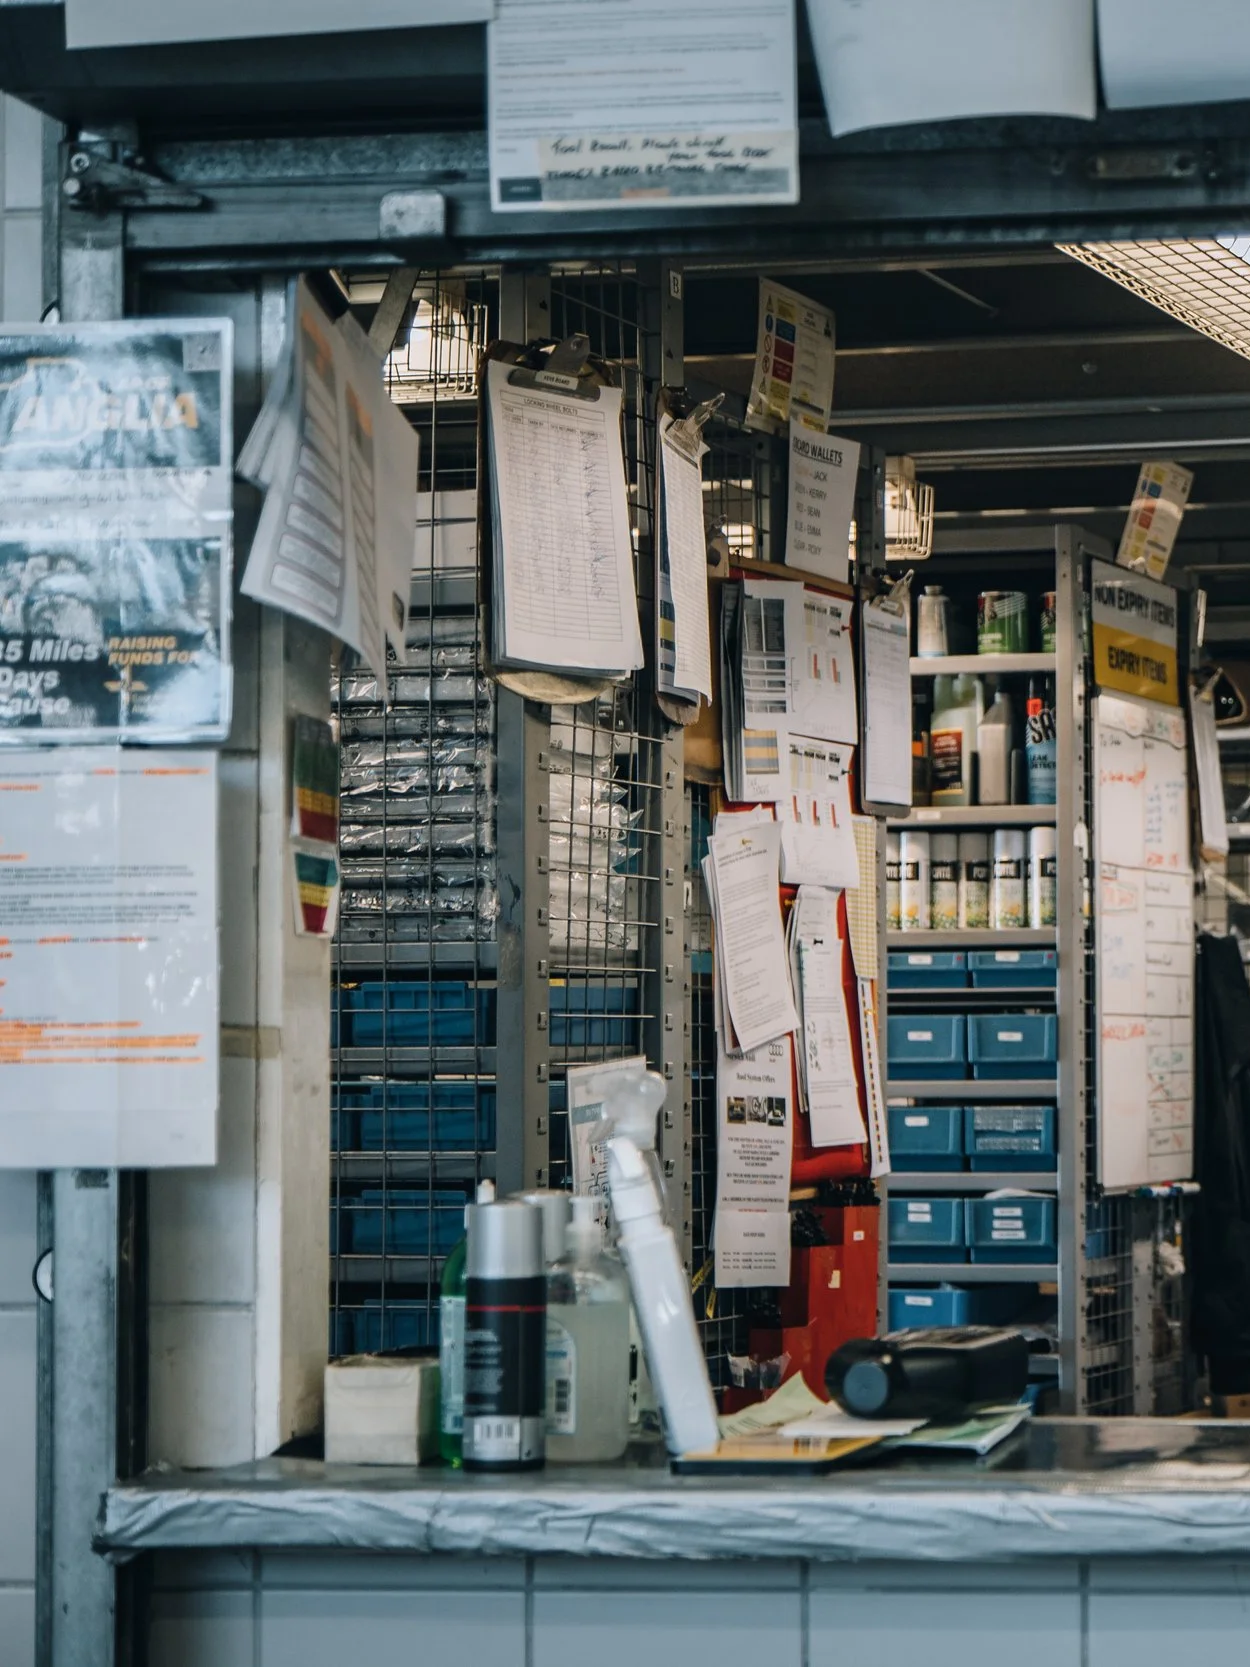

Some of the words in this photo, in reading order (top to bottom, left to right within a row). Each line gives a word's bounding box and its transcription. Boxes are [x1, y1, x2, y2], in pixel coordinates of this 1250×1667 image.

[673, 276, 680, 294] B
[523, 398, 545, 409] LOCKING
[546, 403, 562, 414] WHEEL
[563, 406, 578, 417] BOLTS
[811, 444, 843, 465] WALLETS
[814, 470, 828, 482] JACK
[1095, 586, 1115, 607] NON
[1118, 587, 1149, 619] EXPIRY
[1151, 600, 1174, 628] ITEMS
[29, 639, 100, 662] Miles
[108, 636, 177, 650] RAISING
[108, 652, 163, 667] FUNDS
[1108, 645, 1140, 676] EXPIRY
[1142, 656, 1167, 685] ITEMS
[0, 667, 60, 697] Days
[1028, 708, 1056, 744] SA
